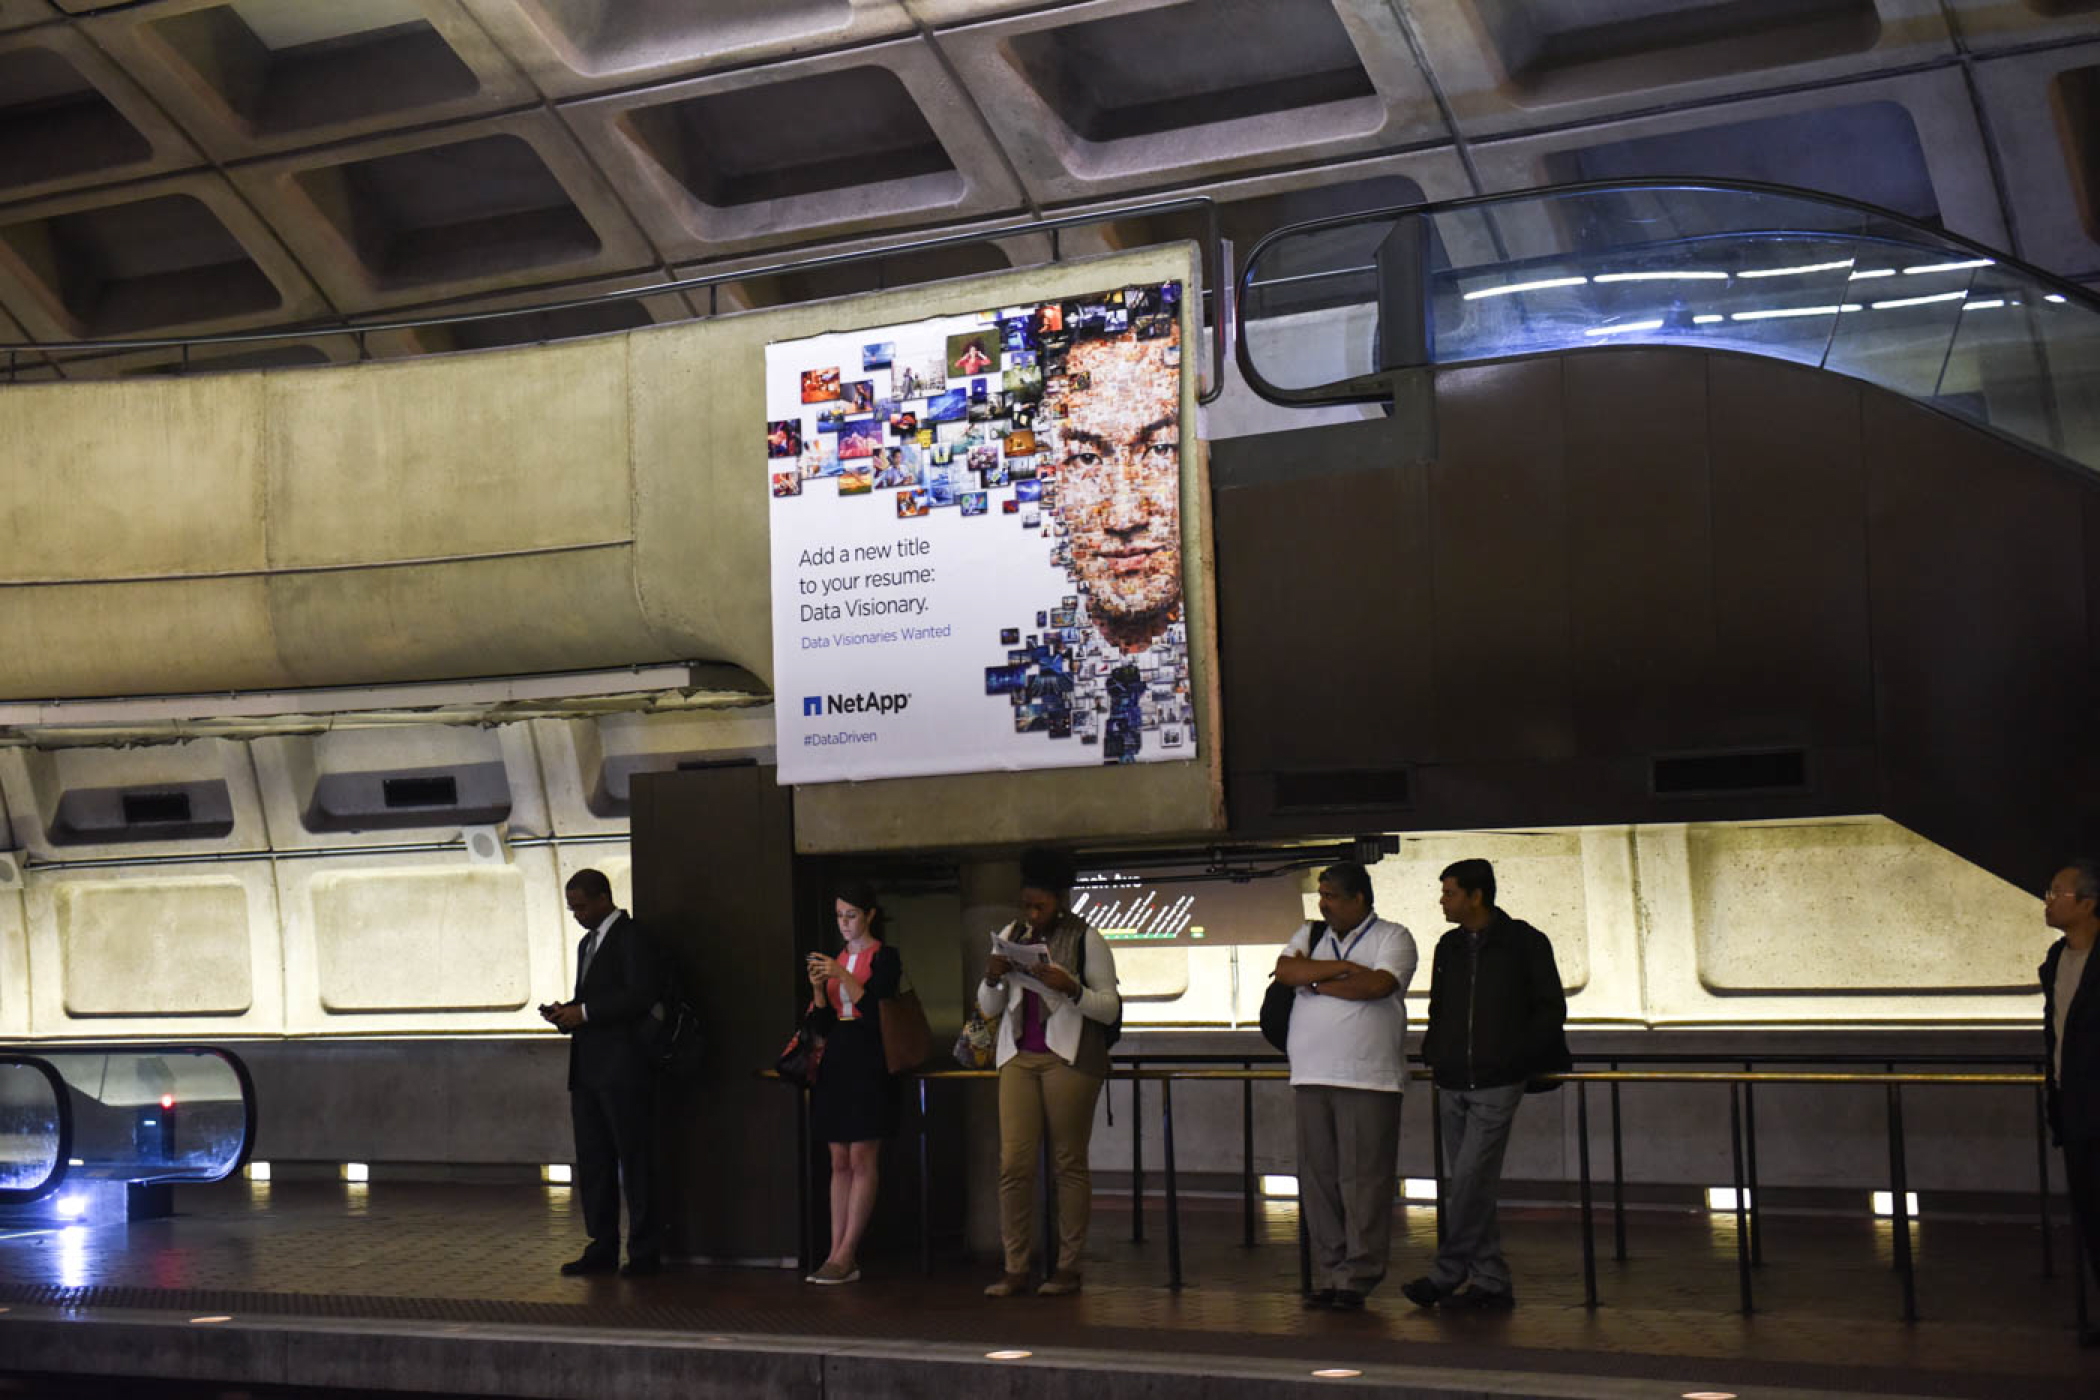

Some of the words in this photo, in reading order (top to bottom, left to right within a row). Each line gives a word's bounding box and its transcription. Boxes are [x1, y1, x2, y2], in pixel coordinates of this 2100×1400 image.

[799, 547, 835, 567] Add
[839, 548, 850, 562] a
[854, 545, 892, 561] new
[897, 537, 931, 558] title
[799, 578, 817, 594] to
[821, 575, 860, 596] your
[865, 567, 936, 588] resume:
[800, 603, 841, 622] Data
[845, 597, 929, 617] Visionary.
[801, 635, 830, 649] Data
[833, 630, 898, 647] Visionaries
[901, 624, 951, 641] Wanted
[827, 692, 908, 714] NetApp
[804, 732, 877, 746] #DataDriven
